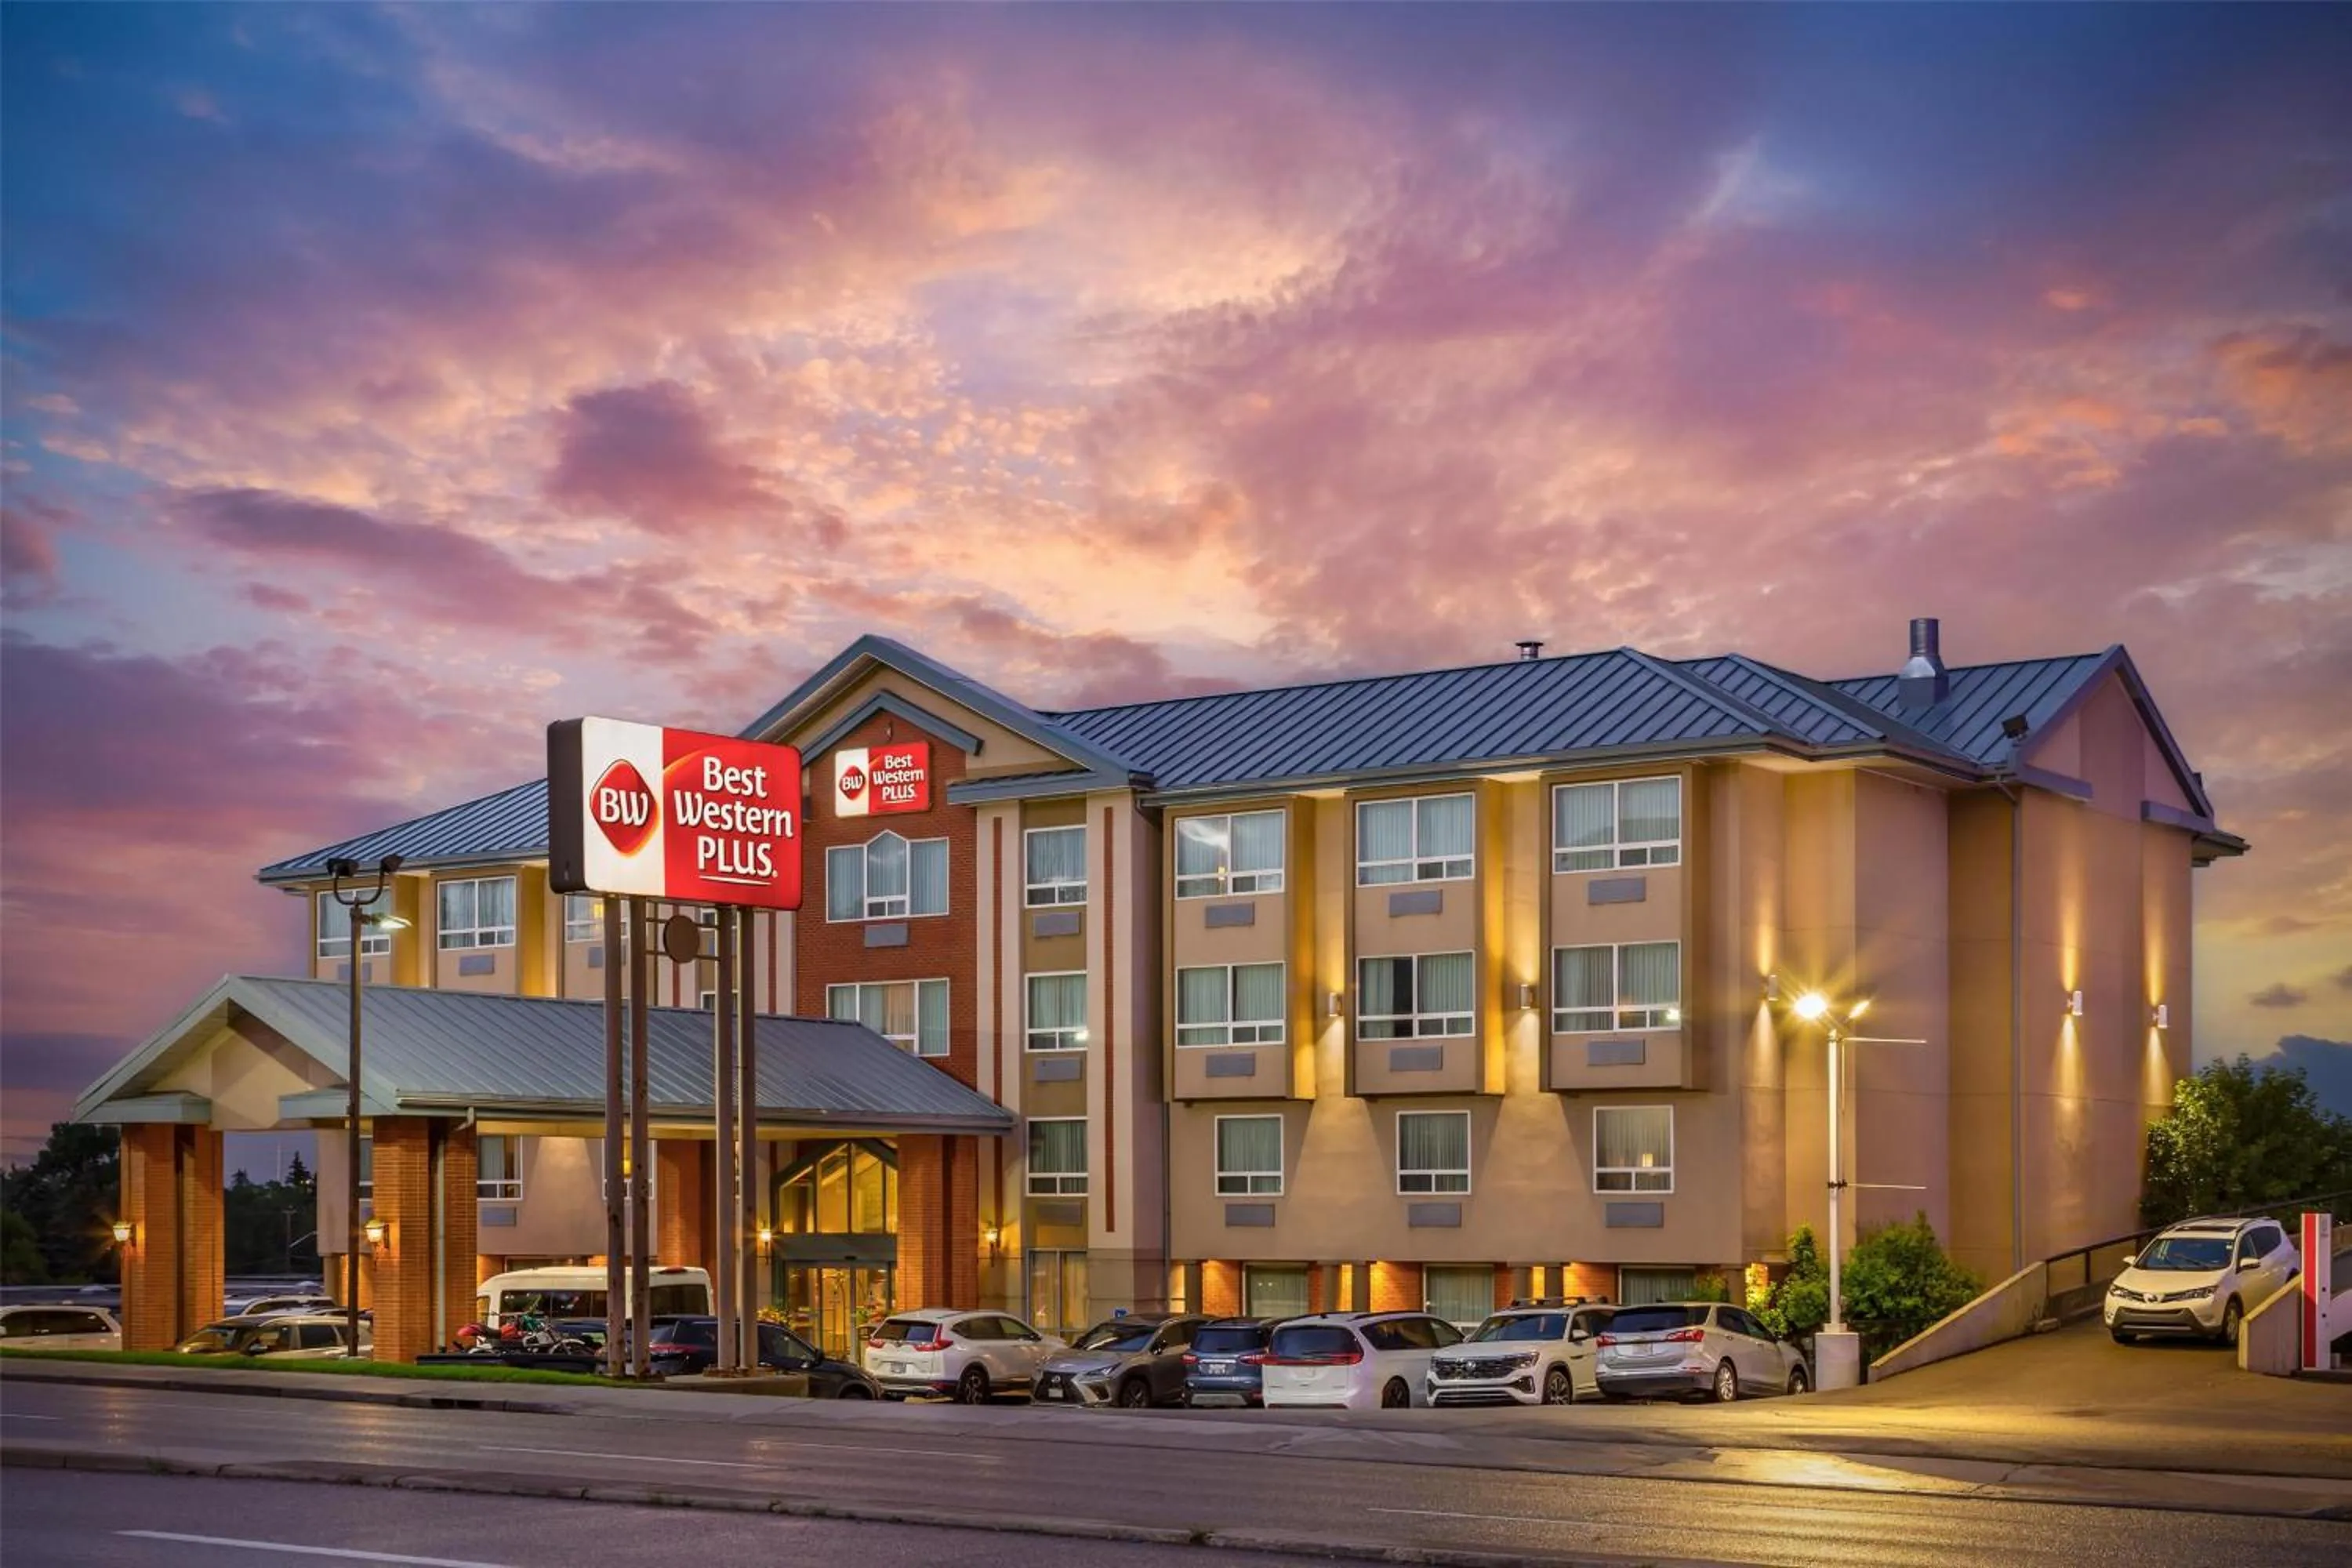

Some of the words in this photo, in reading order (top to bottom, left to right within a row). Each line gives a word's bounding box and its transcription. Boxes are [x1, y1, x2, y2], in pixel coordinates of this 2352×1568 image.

[884, 754, 913, 769] Best
[702, 756, 768, 798] Best
[842, 776, 862, 791] BW
[873, 769, 924, 785] Western
[600, 787, 648, 826] BW
[673, 789, 793, 837] Western
